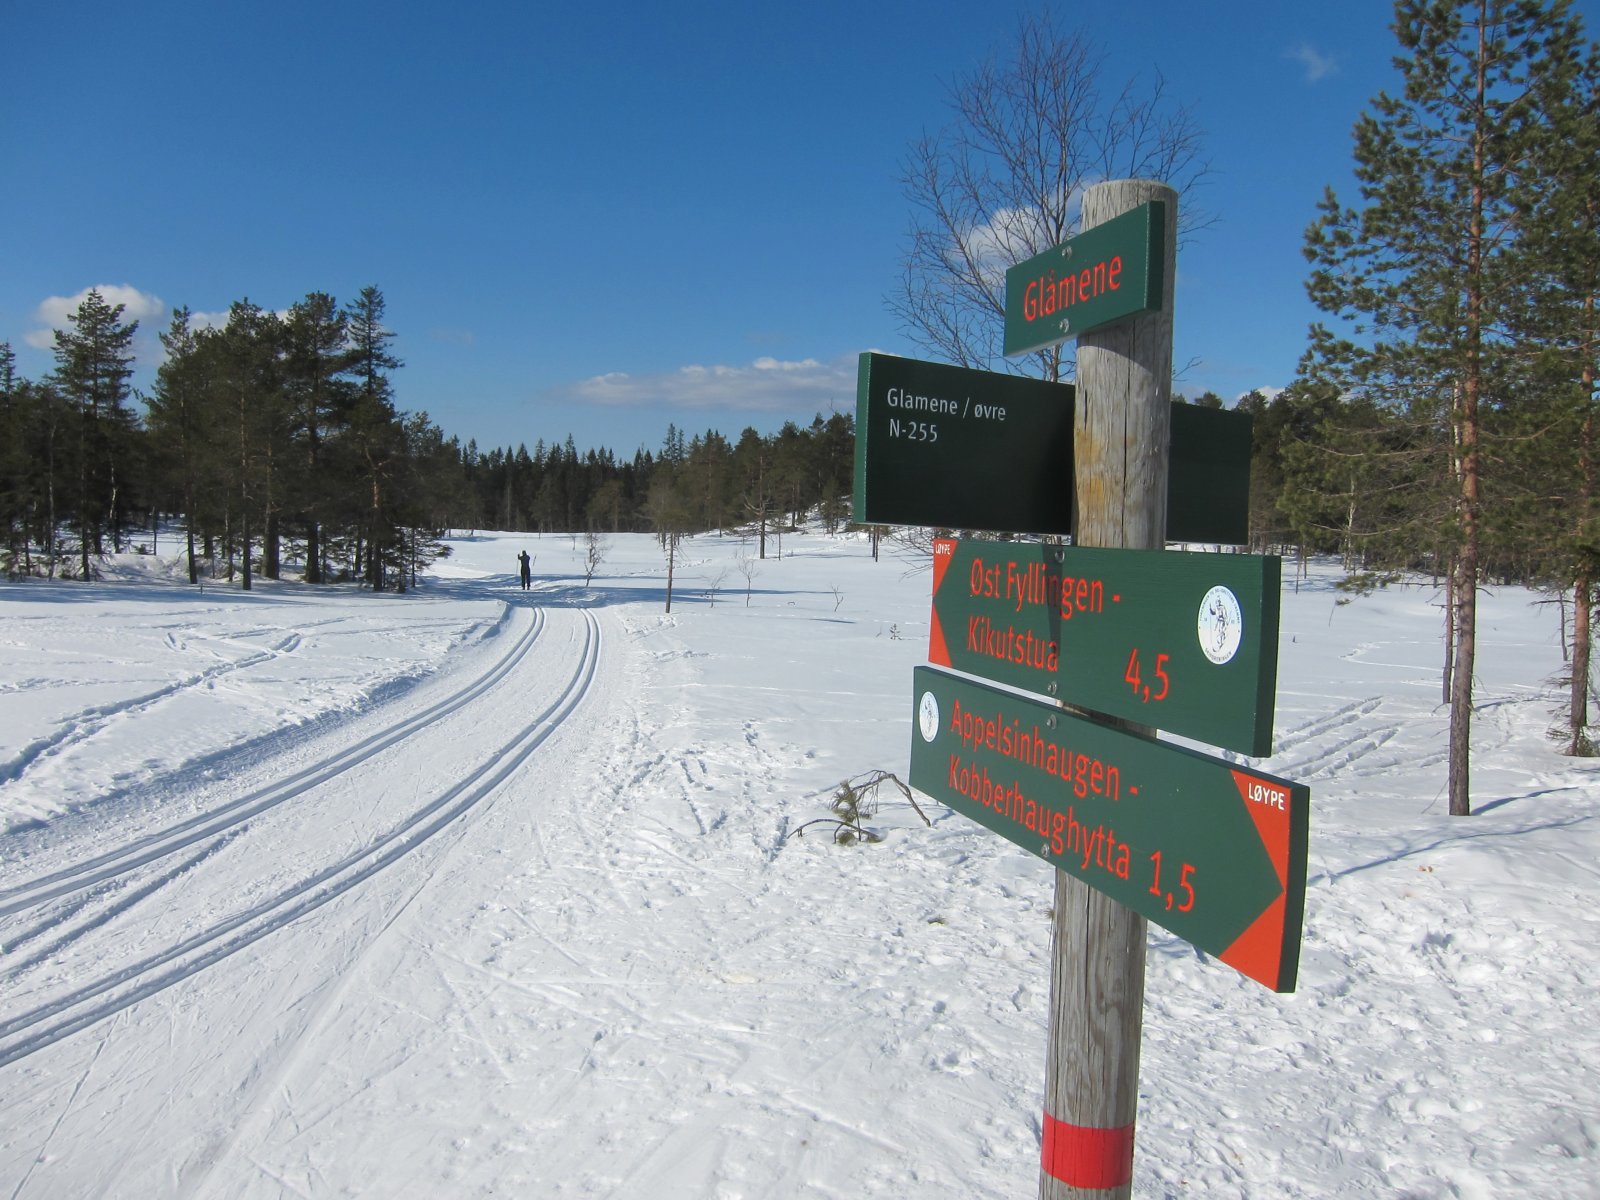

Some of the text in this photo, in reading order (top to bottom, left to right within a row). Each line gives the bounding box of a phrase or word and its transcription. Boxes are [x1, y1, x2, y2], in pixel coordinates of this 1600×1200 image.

[889, 418, 938, 442] N-255
[962, 396, 970, 419] /
[974, 404, 1006, 421] øvre
[935, 543, 951, 555] LØYPE
[970, 558, 1001, 599] Øst
[1006, 561, 1104, 620] Fyllingen
[967, 615, 1058, 672] Kikutstua
[1123, 648, 1170, 703] 4,5
[950, 699, 1120, 801] Appelsinhaugen
[1248, 782, 1285, 811] LØYPE
[948, 754, 1196, 913] Kobberhaughytta 1,5
